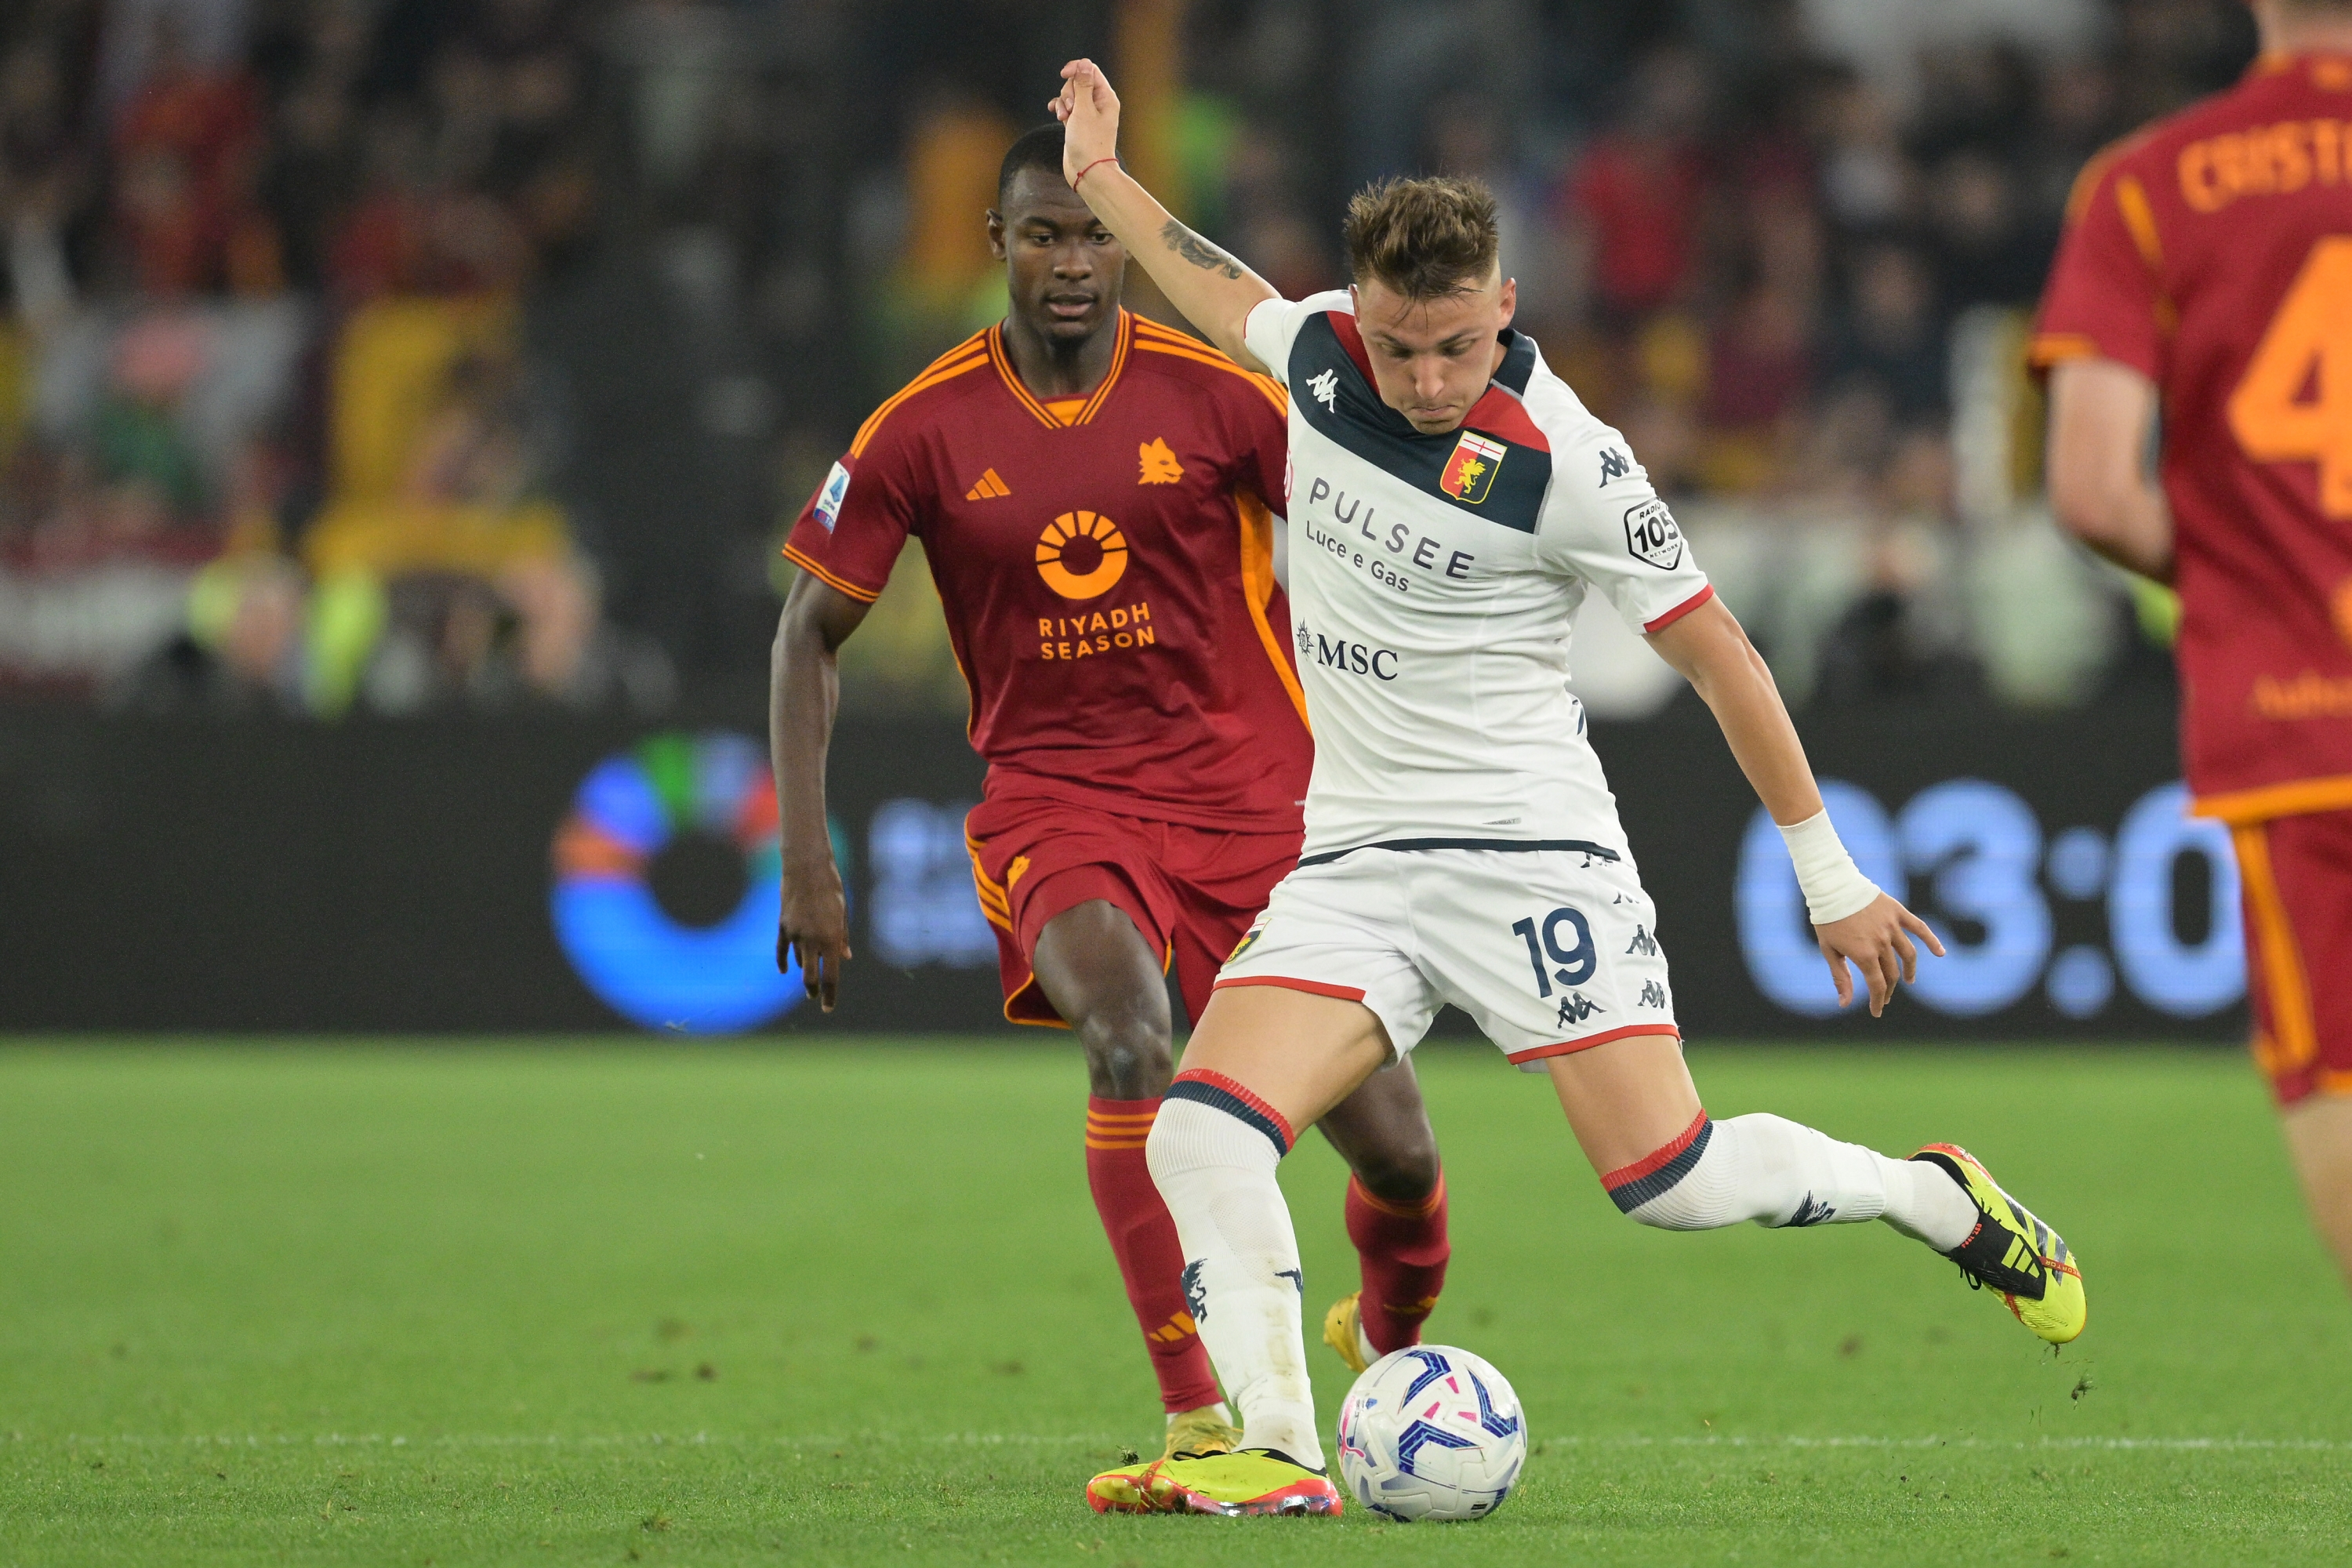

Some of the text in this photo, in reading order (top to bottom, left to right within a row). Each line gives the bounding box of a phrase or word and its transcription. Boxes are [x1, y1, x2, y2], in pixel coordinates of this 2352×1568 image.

[2177, 118, 2352, 213] CRIST
[2227, 234, 2352, 521] 4
[1309, 477, 1475, 579] PULSEE
[1634, 510, 1679, 554] 105
[1639, 502, 1661, 520] RADIO
[1306, 521, 1409, 592] Luce e Gas
[1650, 543, 1679, 558] NETWORK
[1039, 602, 1150, 637] RIYADH
[1040, 626, 1155, 660] SEASON
[1317, 633, 1398, 681] MSC
[1512, 907, 1597, 998] 19
